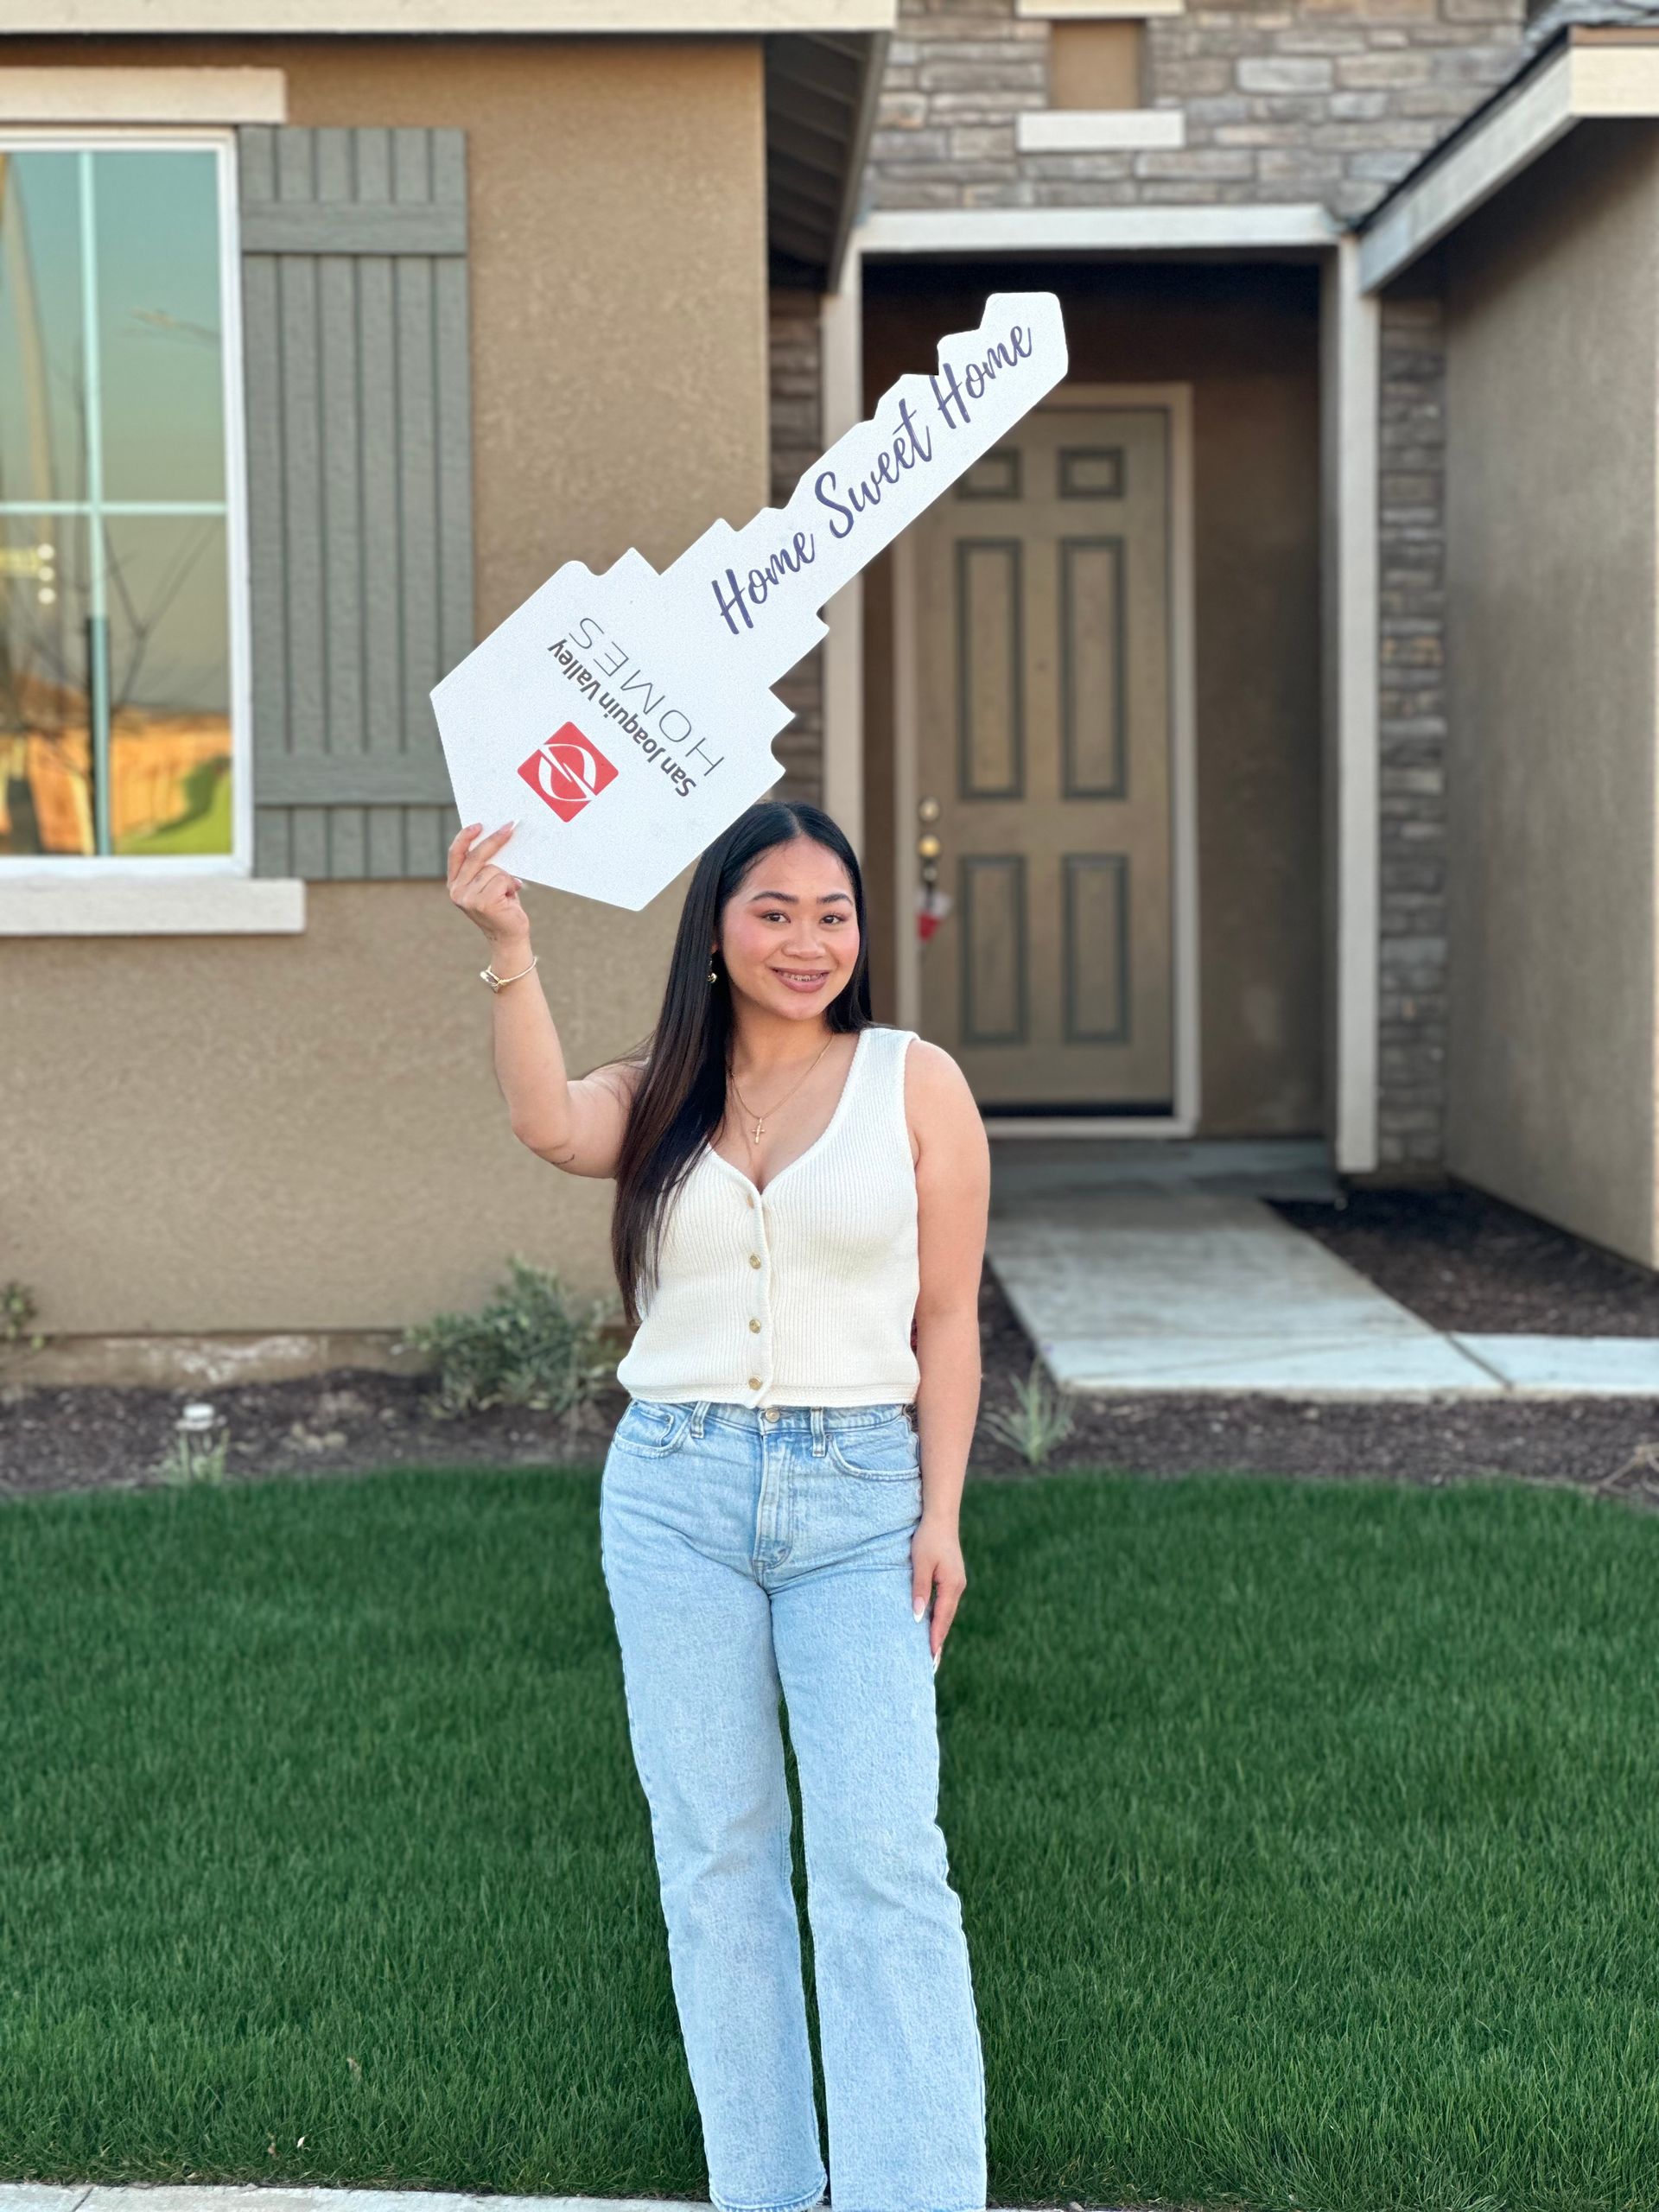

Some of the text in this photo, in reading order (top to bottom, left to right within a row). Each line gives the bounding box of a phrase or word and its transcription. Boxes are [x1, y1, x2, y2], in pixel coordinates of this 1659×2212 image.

[711, 325, 1033, 635] Home Sweet Home
[547, 638, 697, 798] San Joaquin Valley
[568, 617, 725, 777] HOMES
